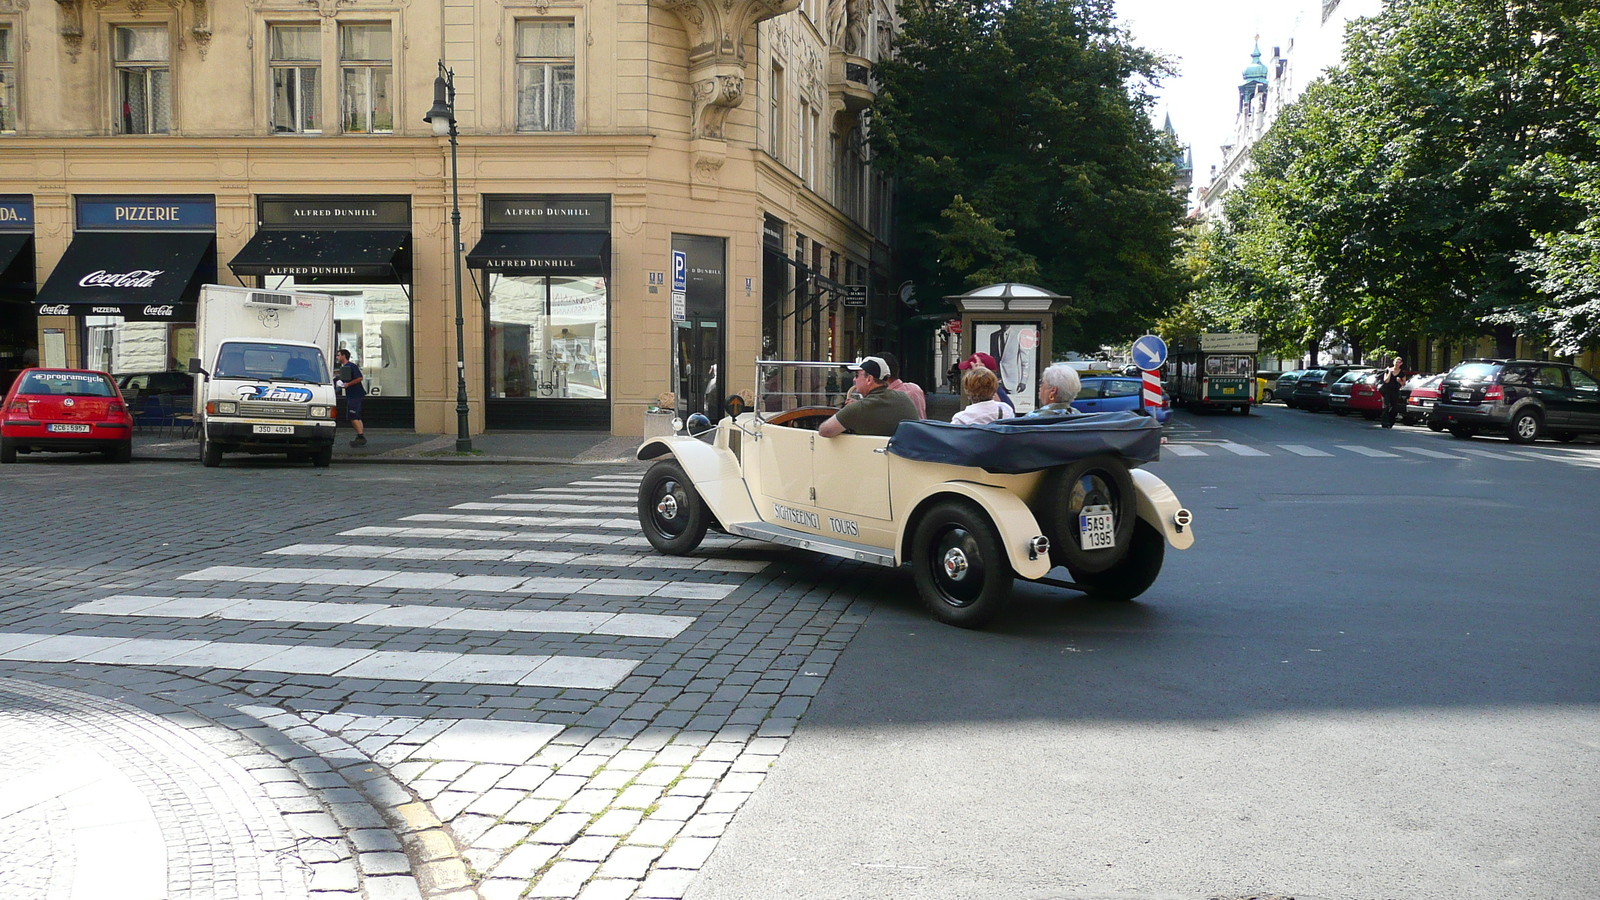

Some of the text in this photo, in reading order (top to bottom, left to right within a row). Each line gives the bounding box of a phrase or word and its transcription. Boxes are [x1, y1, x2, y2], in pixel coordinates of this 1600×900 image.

[115, 206, 180, 221] PIZZERIE
[334, 208, 378, 216] DUNHILL
[504, 208, 591, 216] ALFRED DUNHILL
[486, 259, 576, 267] ALFRED DUNHILL
[675, 255, 684, 280] P
[269, 266, 356, 274] ALFRED DUNHILL
[79, 270, 165, 288] Coca-Cola
[39, 304, 71, 315] Coca-Cola
[92, 306, 122, 314] PIZZERIA
[143, 304, 174, 316] Coca-Cola
[46, 373, 104, 383] programcycle
[774, 503, 858, 536] SIGHTSEEING TOURS
[1087, 517, 1105, 532] 5A9
[1089, 531, 1112, 547] 1395
